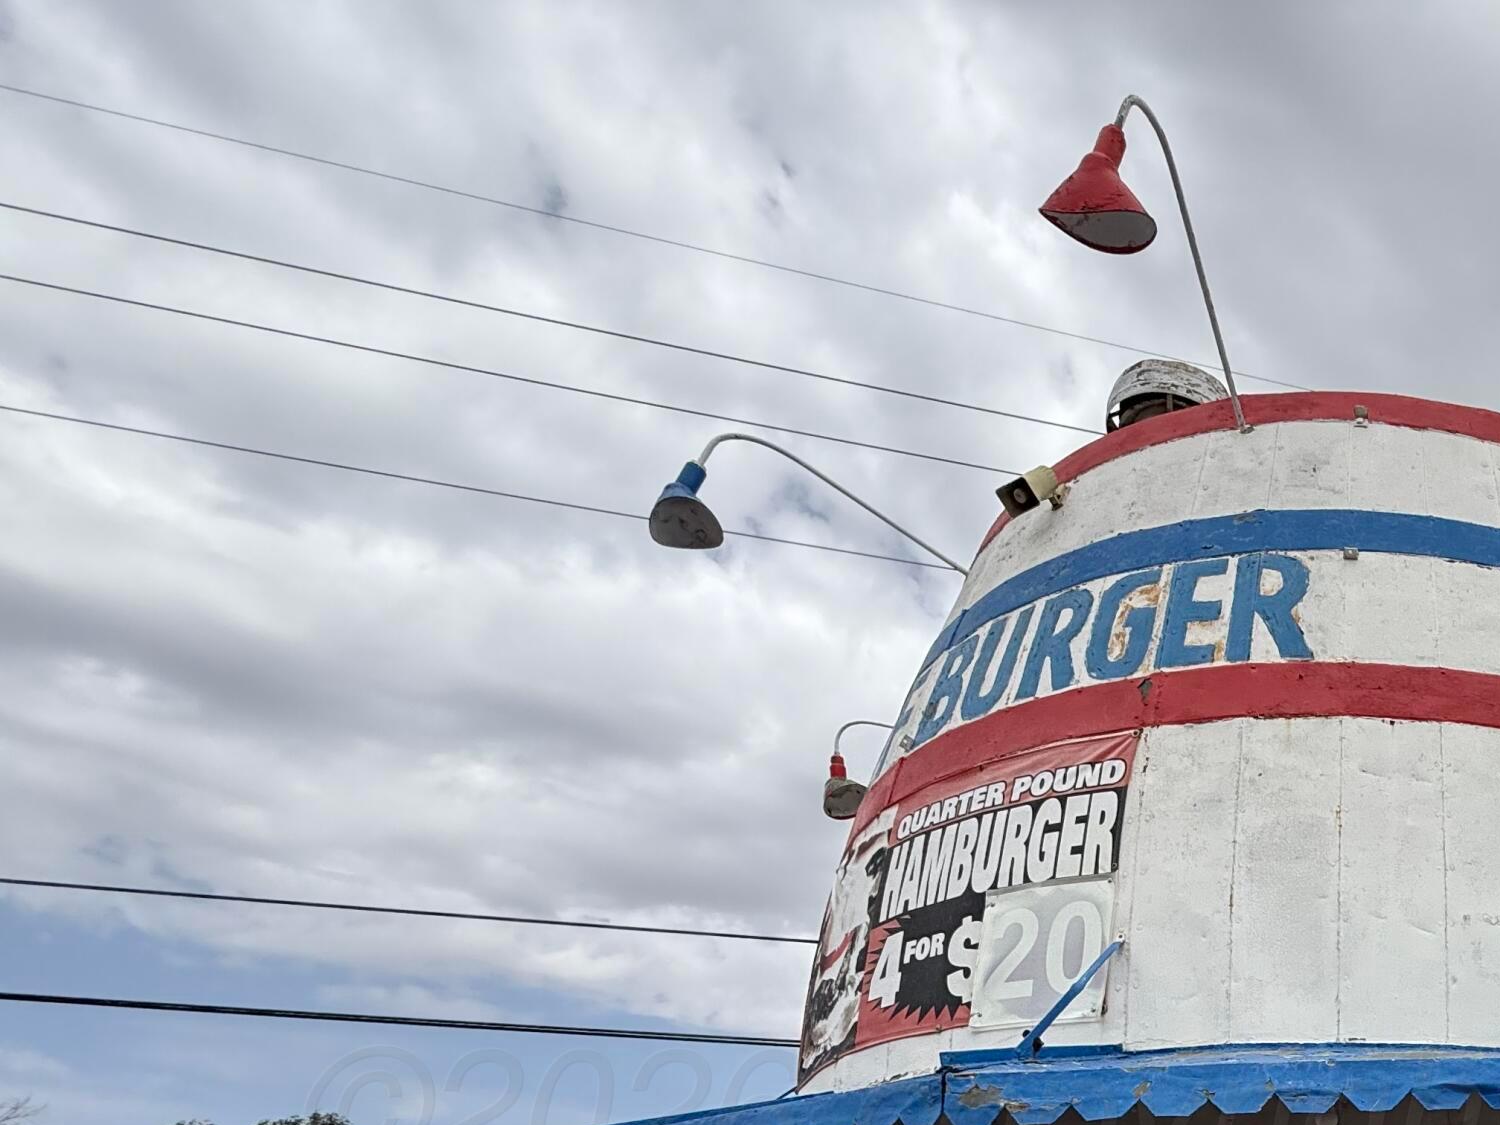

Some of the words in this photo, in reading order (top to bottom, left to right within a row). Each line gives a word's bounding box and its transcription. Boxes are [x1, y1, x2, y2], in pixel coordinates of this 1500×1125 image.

[897, 781, 1005, 840] QUARTER
[1010, 758, 1127, 802] POUND
[878, 789, 1120, 923] HAMBURGER
[867, 929, 904, 1009] 4
[903, 932, 945, 964] FOR
